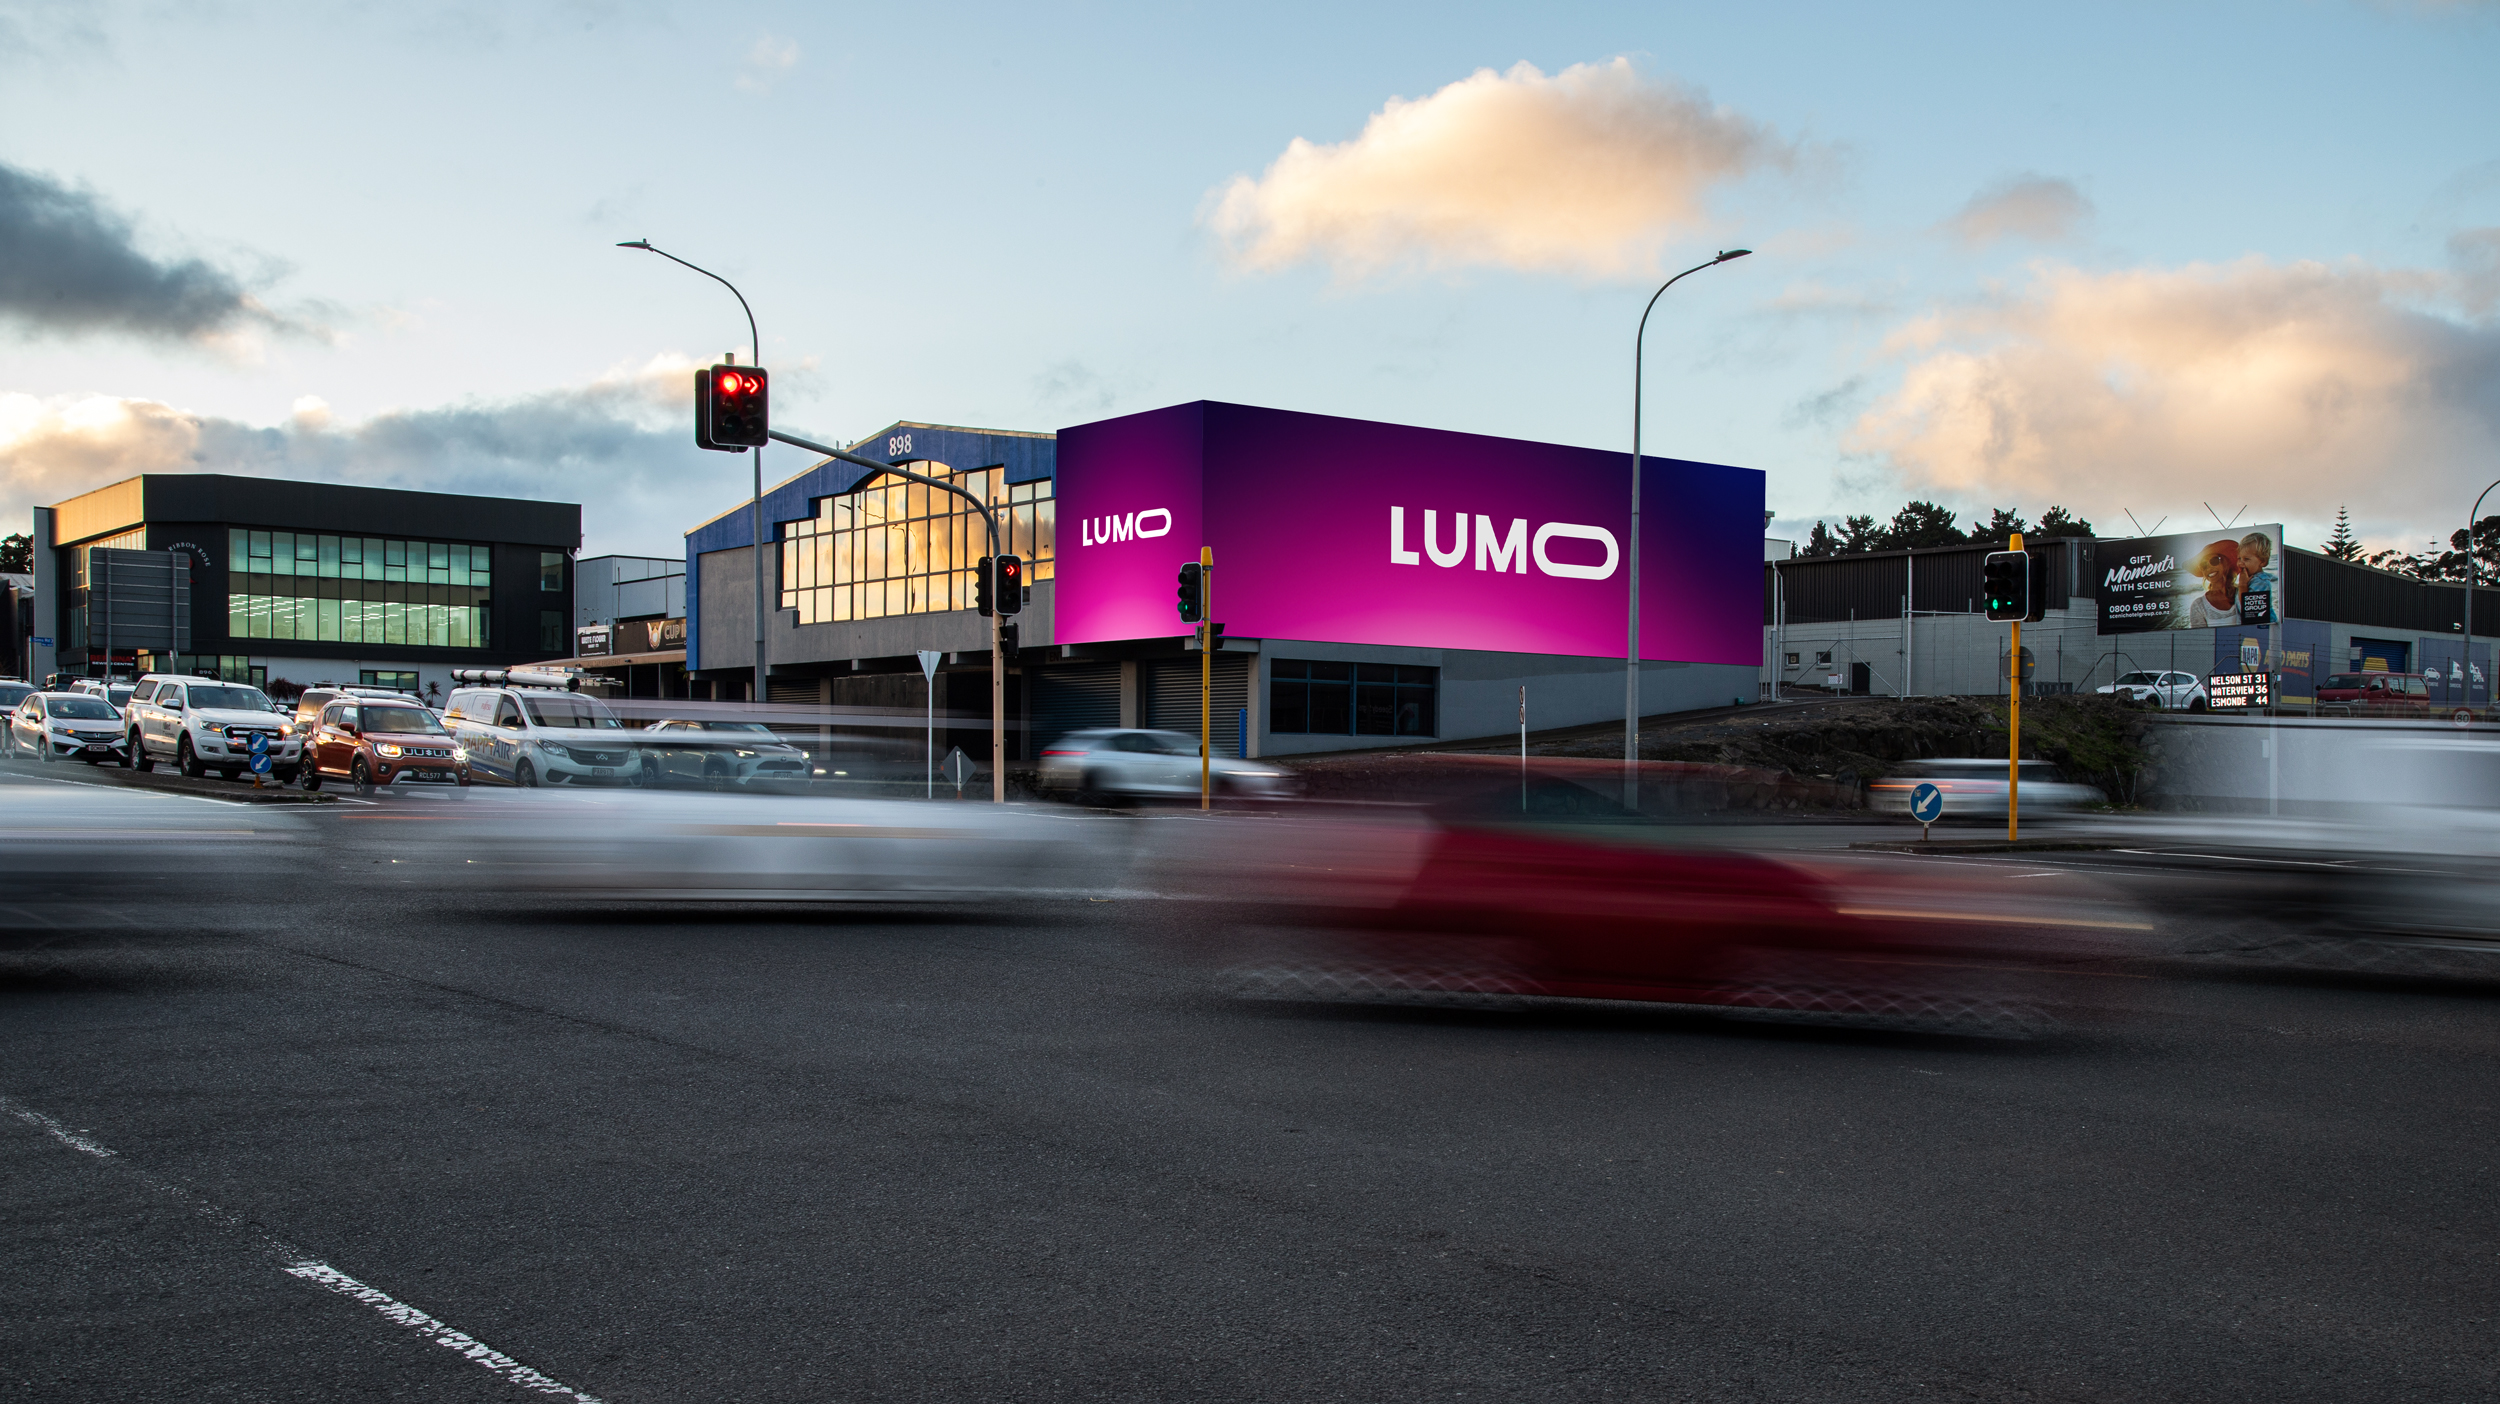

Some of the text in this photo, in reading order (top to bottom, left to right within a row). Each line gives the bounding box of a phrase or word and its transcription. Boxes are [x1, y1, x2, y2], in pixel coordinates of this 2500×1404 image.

[890, 434, 912, 456] 898
[1082, 508, 1172, 546] LUMO
[1391, 506, 1620, 580] LUMO
[168, 542, 211, 567] RIBBON ROSE
[2130, 555, 2152, 564] GIFT
[2104, 554, 2174, 587] Moments
[2111, 580, 2171, 592] WITH SCENIC
[2109, 605, 2130, 613] 0800
[2132, 603, 2144, 611] 69
[2146, 602, 2156, 610] 69
[2109, 611, 2170, 619] scenichotelgroup.co.nz
[664, 624, 680, 639] CUP
[2242, 647, 2259, 665] NAPA
[2286, 651, 2310, 668] PARTS
[2211, 674, 2266, 685] NELSON ST 31
[2211, 685, 2268, 696] WATERVIEW 36
[2211, 696, 2268, 707] ESMONDE 44
[2456, 714, 2470, 722] 80
